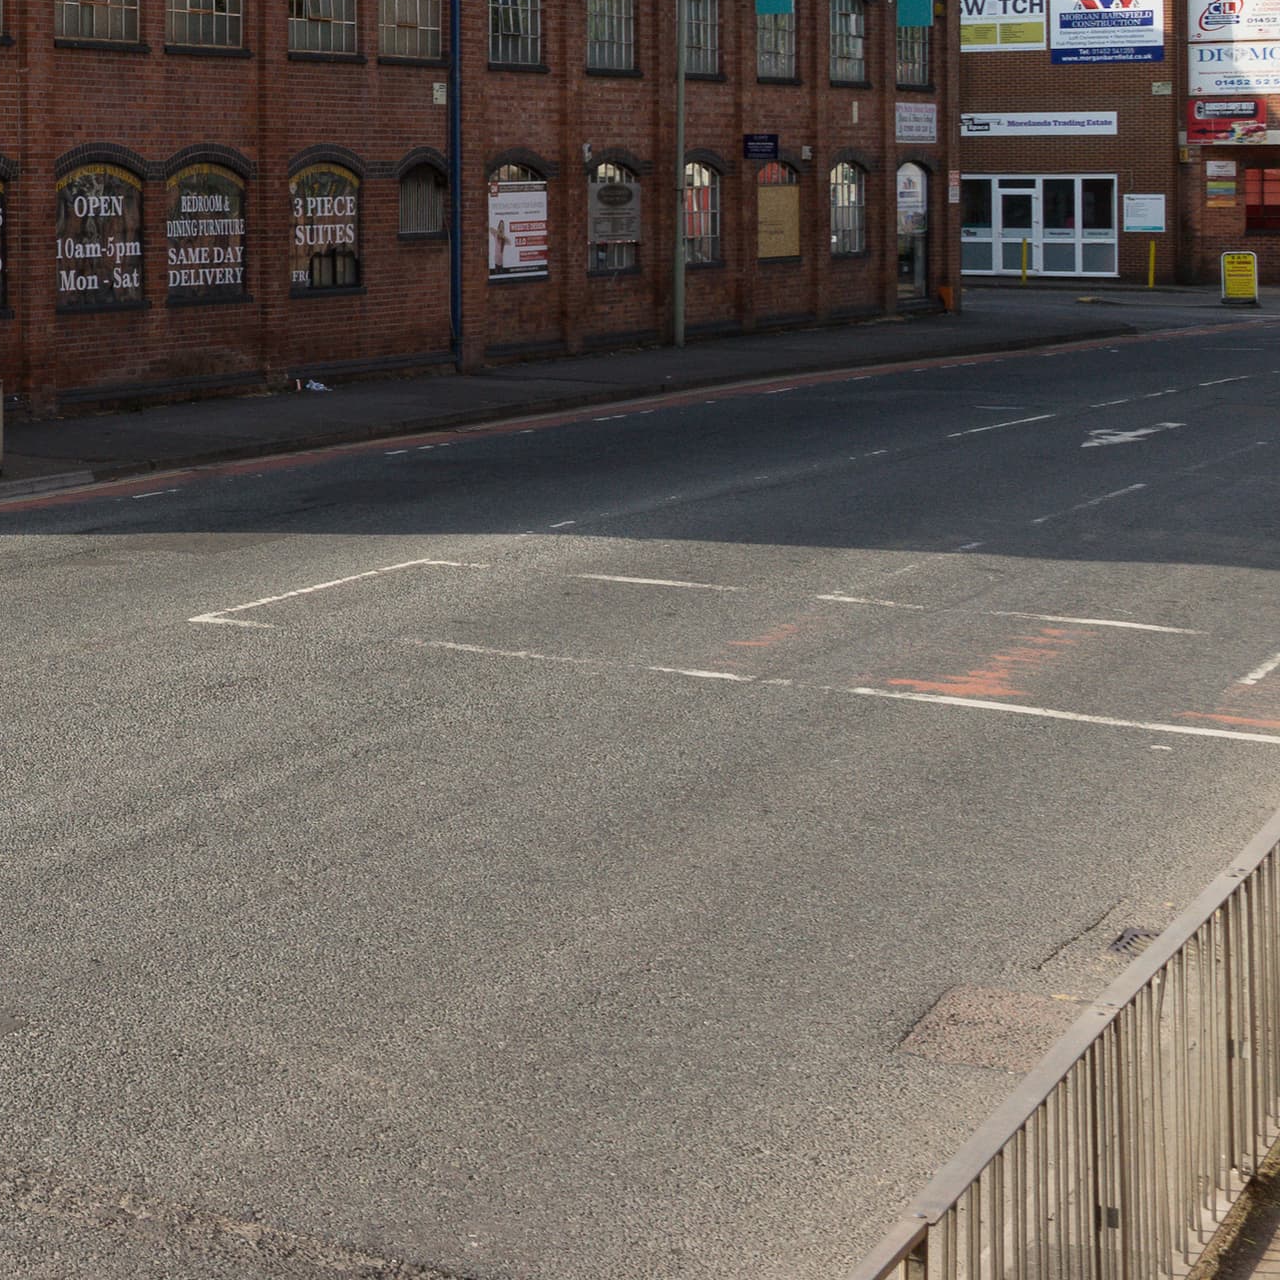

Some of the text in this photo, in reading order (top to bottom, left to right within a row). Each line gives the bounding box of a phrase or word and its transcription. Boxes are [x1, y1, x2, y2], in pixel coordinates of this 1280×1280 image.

[1061, 13, 1100, 21] MORGAN
[1072, 19, 1141, 27] CONSTRUCTION
[1052, 119, 1086, 128] Trading
[74, 196, 123, 217] OPEN
[181, 195, 230, 212] BEDROOM &
[294, 196, 356, 217] 3 PIECE
[167, 219, 245, 237] DINING FURNITURE
[295, 224, 354, 246] SUITES
[56, 237, 142, 264] 10am-5pm
[168, 246, 244, 266] SAME DAY
[59, 270, 99, 291] Mon
[113, 267, 140, 289] Sat
[168, 267, 244, 287] DELIVERY
